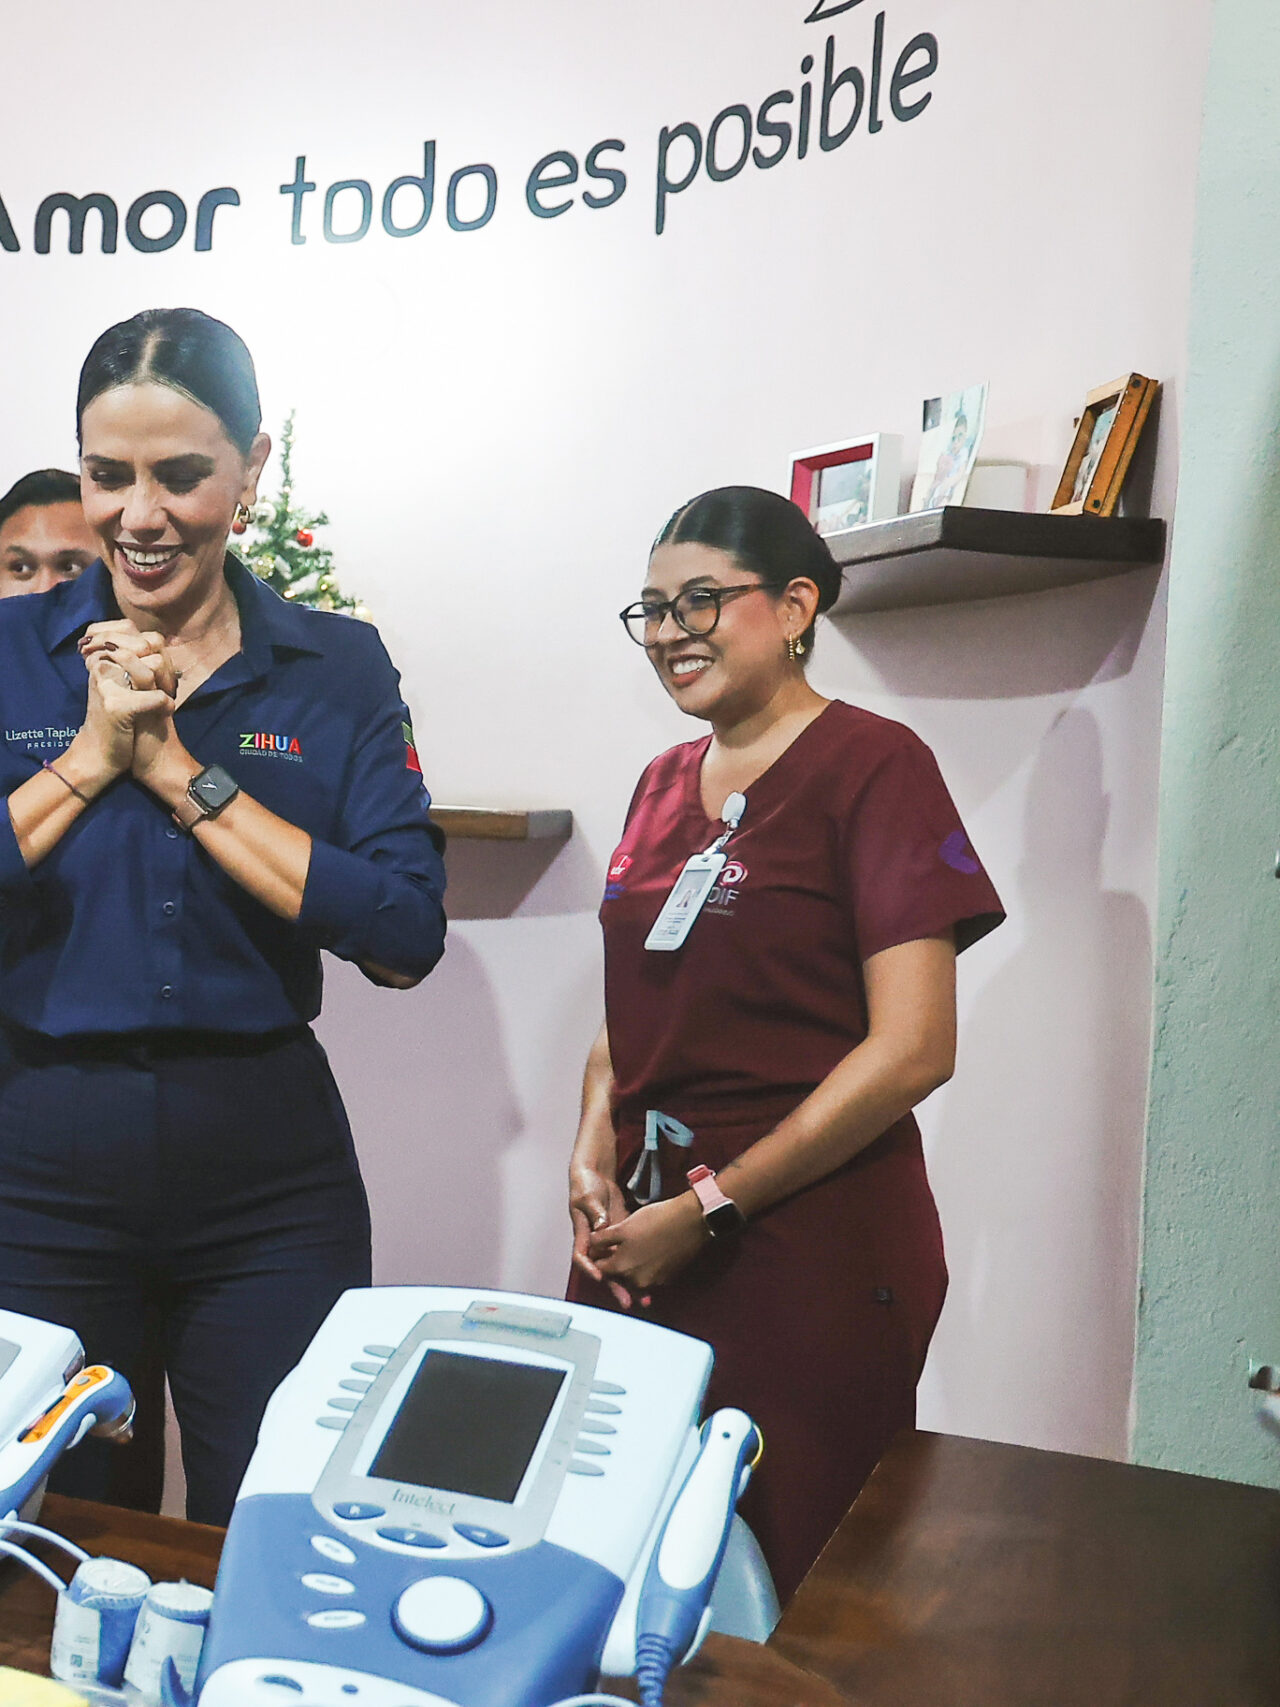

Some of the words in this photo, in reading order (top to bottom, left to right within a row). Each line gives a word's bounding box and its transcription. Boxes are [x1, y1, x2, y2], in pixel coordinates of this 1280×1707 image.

[280, 139, 498, 245] todo
[525, 138, 627, 219] es
[656, 11, 939, 236] posible
[27, 741, 70, 750] PRESIDE
[239, 732, 302, 755] ZIHUA
